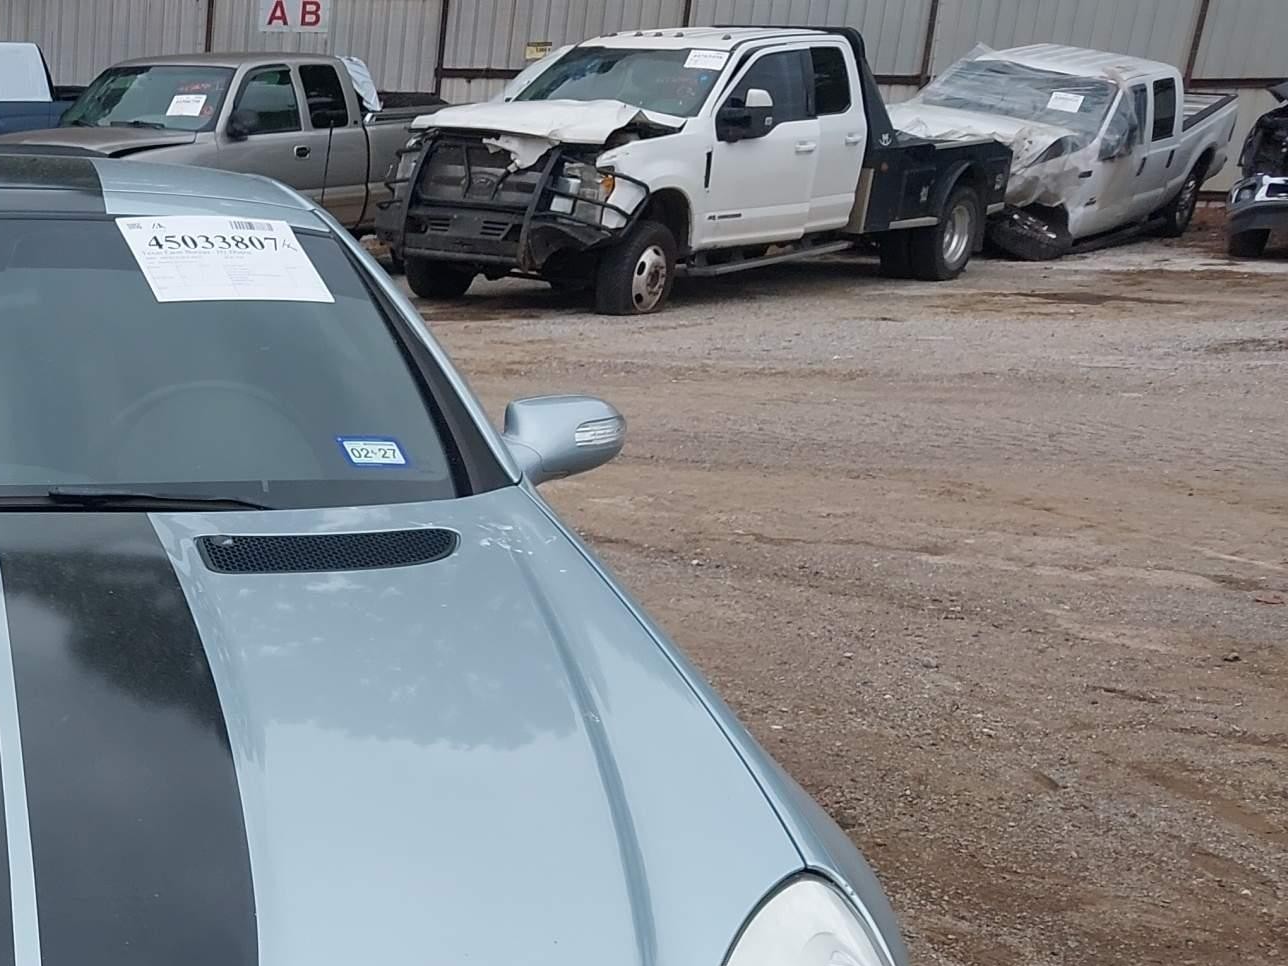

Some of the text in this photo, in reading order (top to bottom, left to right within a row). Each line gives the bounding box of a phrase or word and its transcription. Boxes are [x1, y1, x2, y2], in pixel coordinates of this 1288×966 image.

[267, 0, 320, 26] A B
[148, 235, 278, 252] 45033807
